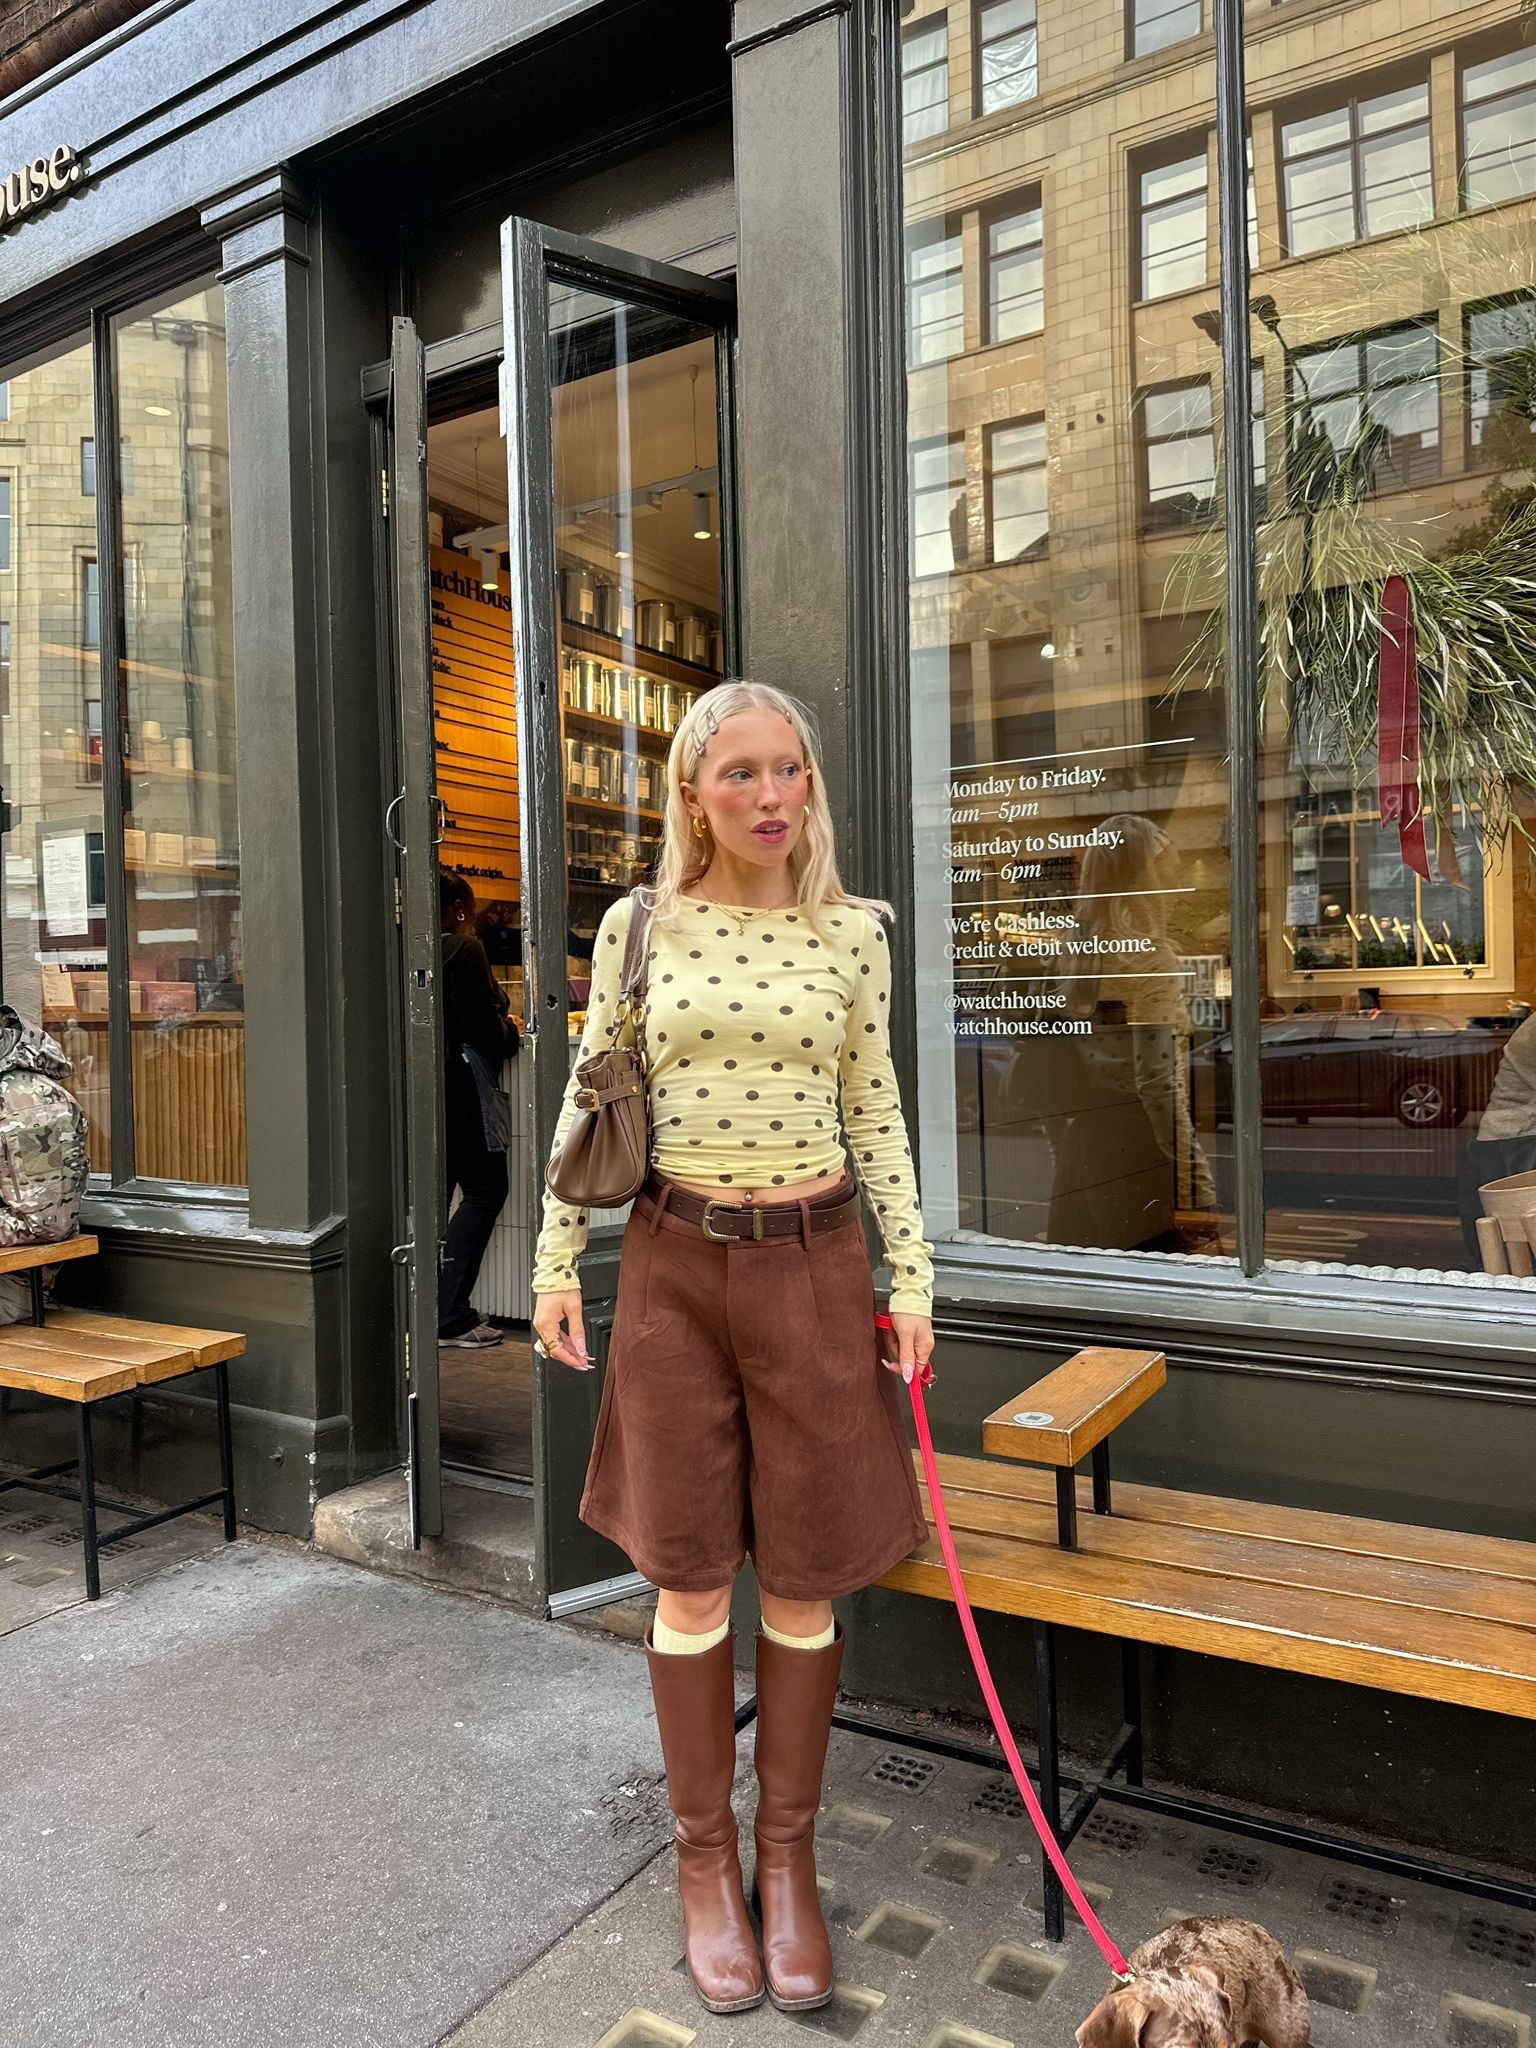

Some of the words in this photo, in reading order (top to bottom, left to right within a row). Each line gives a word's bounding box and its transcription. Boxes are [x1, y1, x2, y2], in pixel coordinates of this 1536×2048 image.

[942, 776, 1015, 799] Monday
[1019, 775, 1038, 790] to
[1041, 765, 1107, 789] Friday.
[942, 836, 1022, 858] Saturday
[1025, 835, 1044, 851] to
[1048, 827, 1125, 850] Sunday.
[943, 916, 991, 934] We’re
[994, 911, 1080, 932] Cashless.
[943, 941, 995, 960] Credit
[999, 940, 1013, 958] &
[1017, 938, 1063, 956] debit
[1067, 935, 1156, 954] welcome.
[944, 991, 1066, 1013] @watchhouse
[944, 1017, 1093, 1036] watchhouse.com
